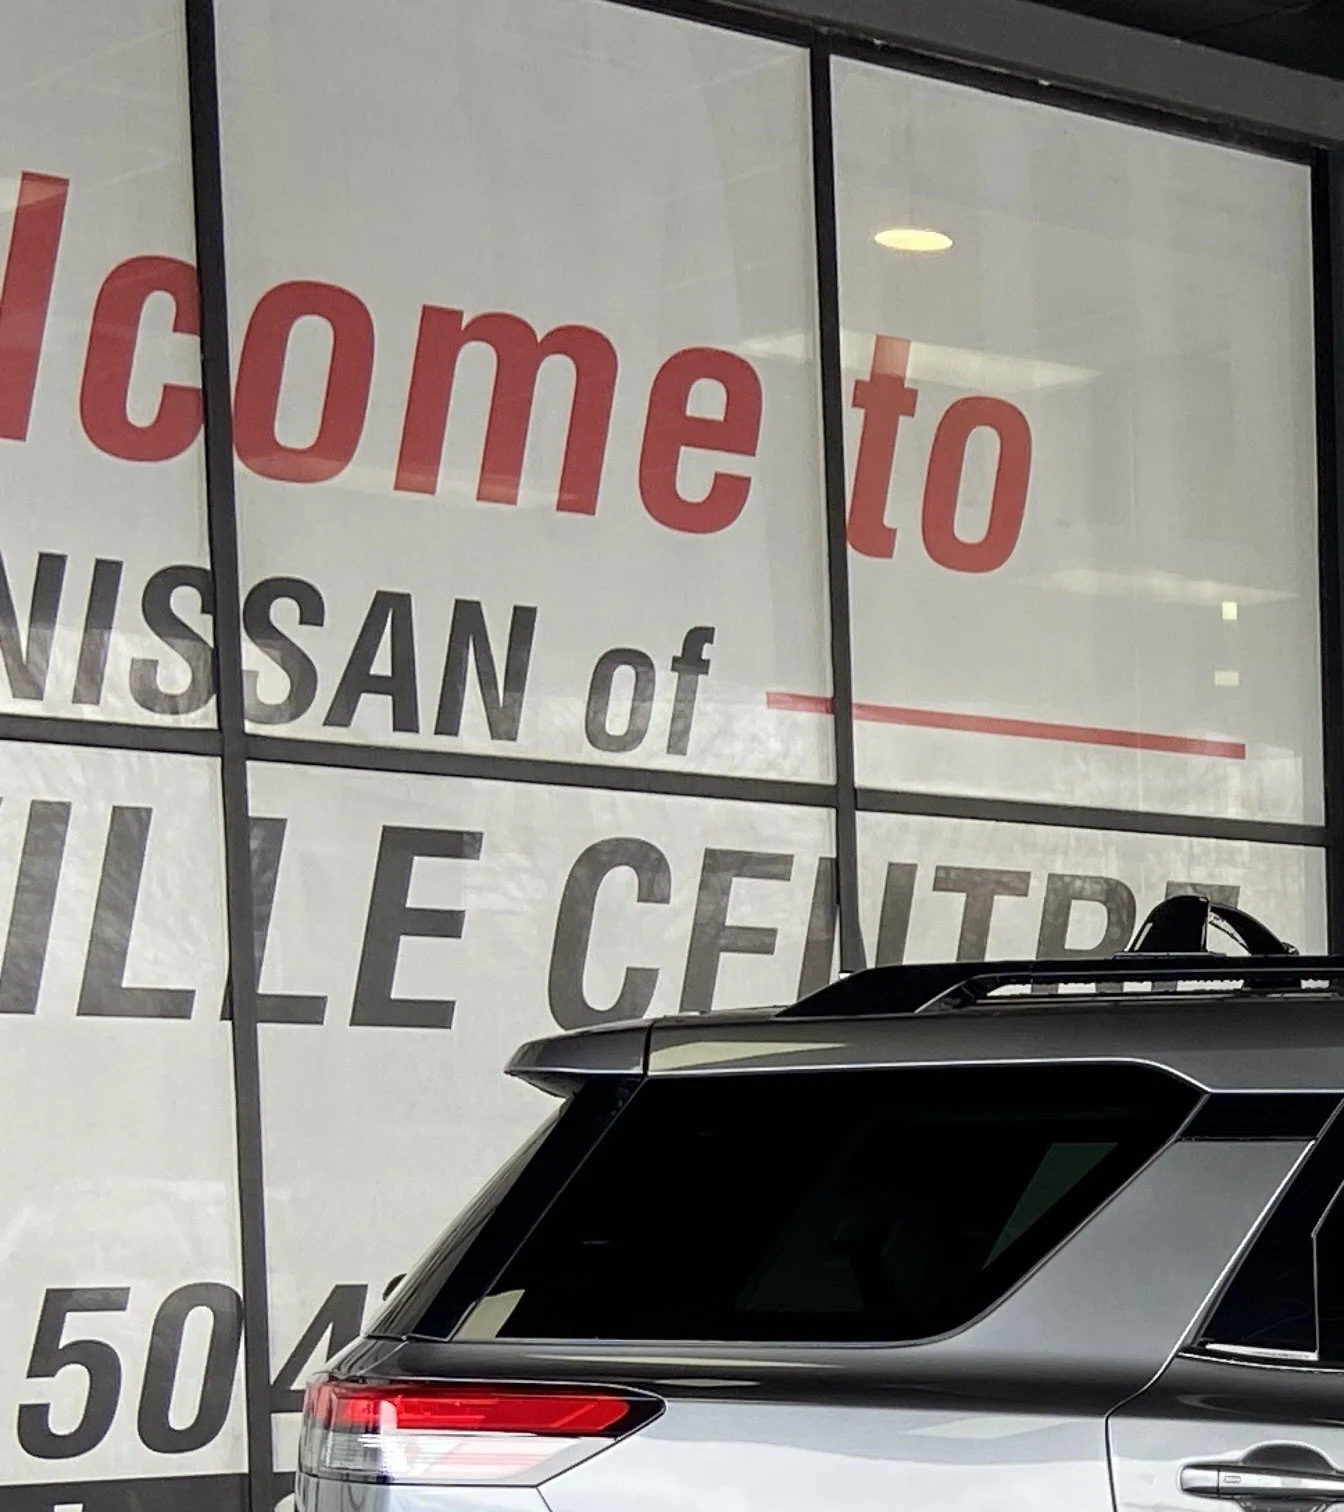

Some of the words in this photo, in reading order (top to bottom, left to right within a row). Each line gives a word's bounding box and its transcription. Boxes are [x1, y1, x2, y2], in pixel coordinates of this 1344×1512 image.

[845, 337, 1034, 574] to
[0, 551, 537, 743] NISSAN
[584, 626, 715, 757] of
[548, 836, 1241, 1030] CENTR
[17, 1282, 407, 1459] 504
